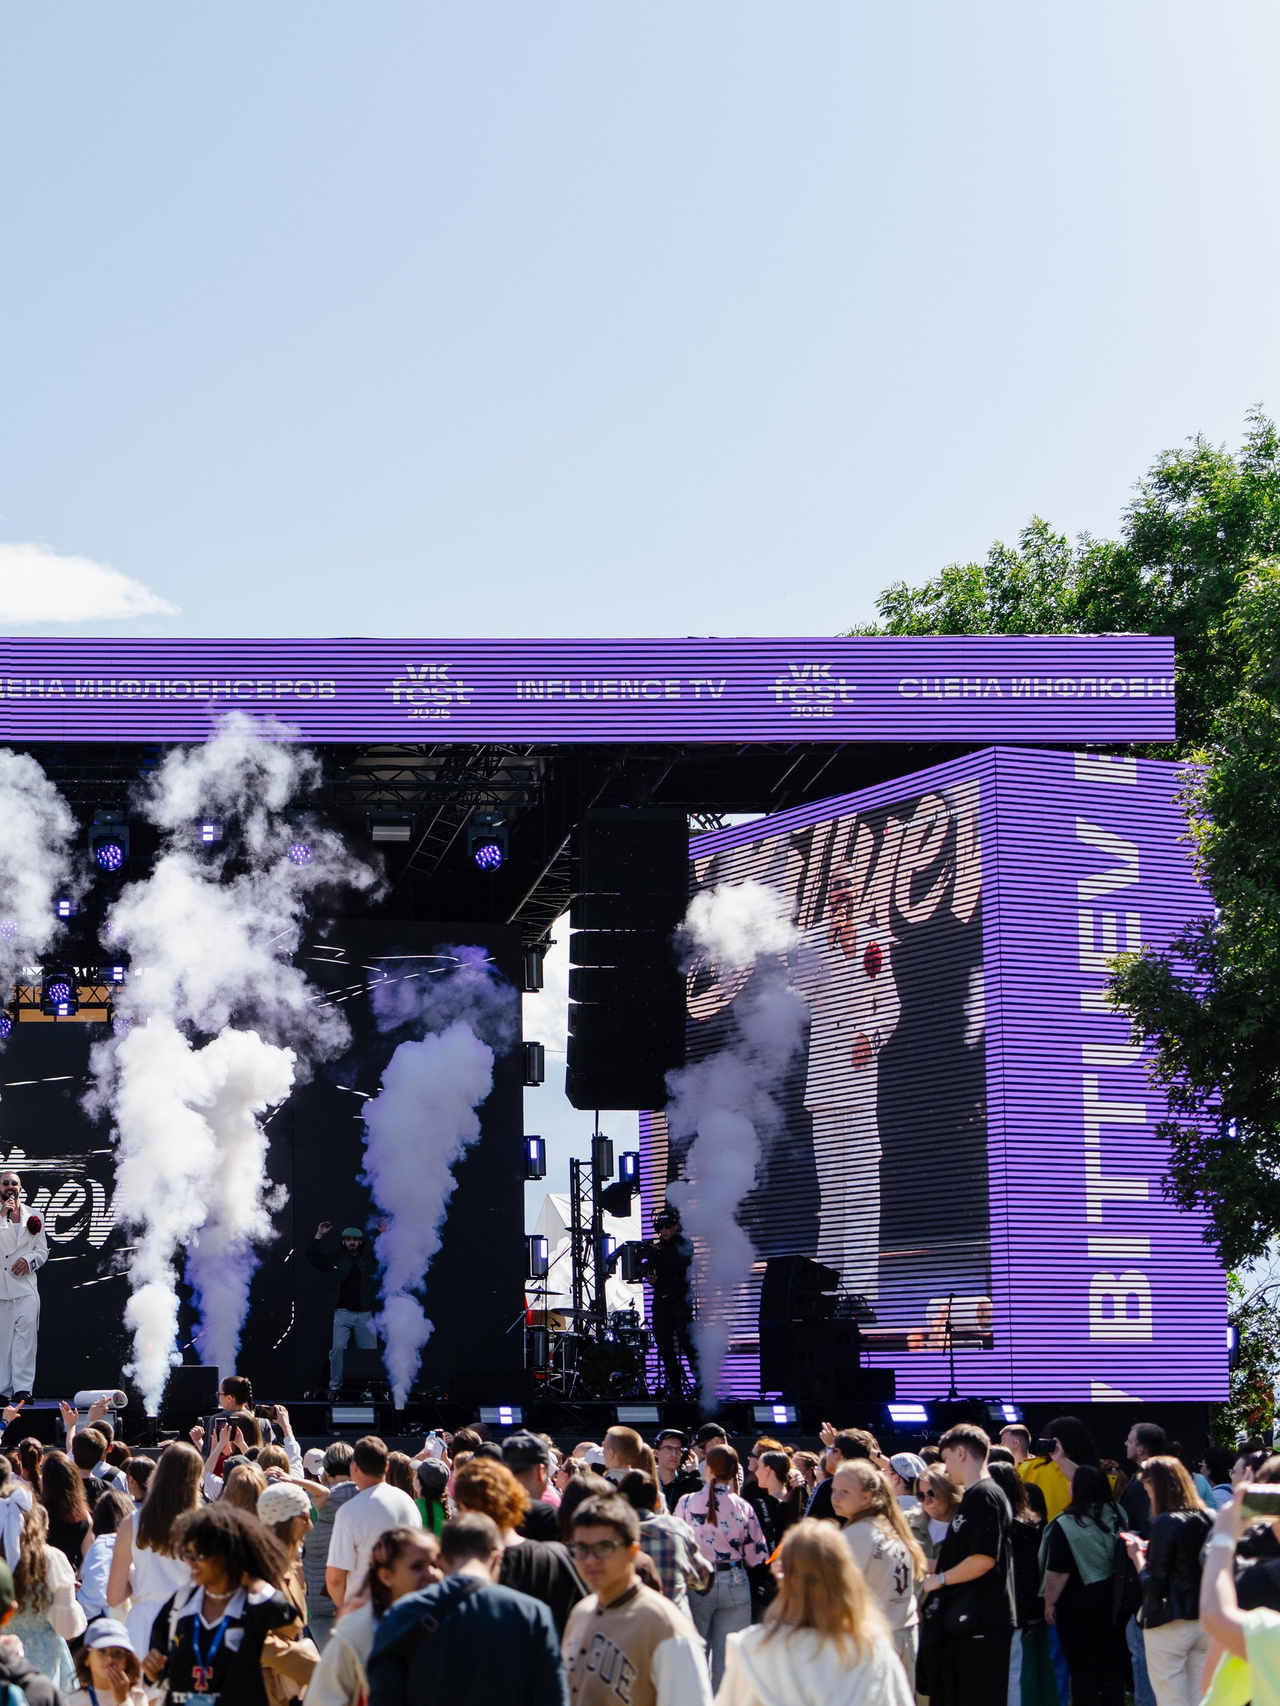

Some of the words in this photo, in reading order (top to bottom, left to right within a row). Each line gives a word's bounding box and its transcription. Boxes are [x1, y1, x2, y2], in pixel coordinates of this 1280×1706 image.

[405, 663, 453, 683] VK
[788, 662, 835, 682] VK
[75, 679, 337, 699] ИНФЛЮЕНСЕРОВ
[385, 677, 474, 705] fest
[516, 680, 680, 699] INFLUENCE
[688, 679, 727, 699] TV
[767, 676, 857, 704] fest
[898, 678, 1003, 702] СЦЕНА
[1075, 816, 1153, 1342] BITTUEV
